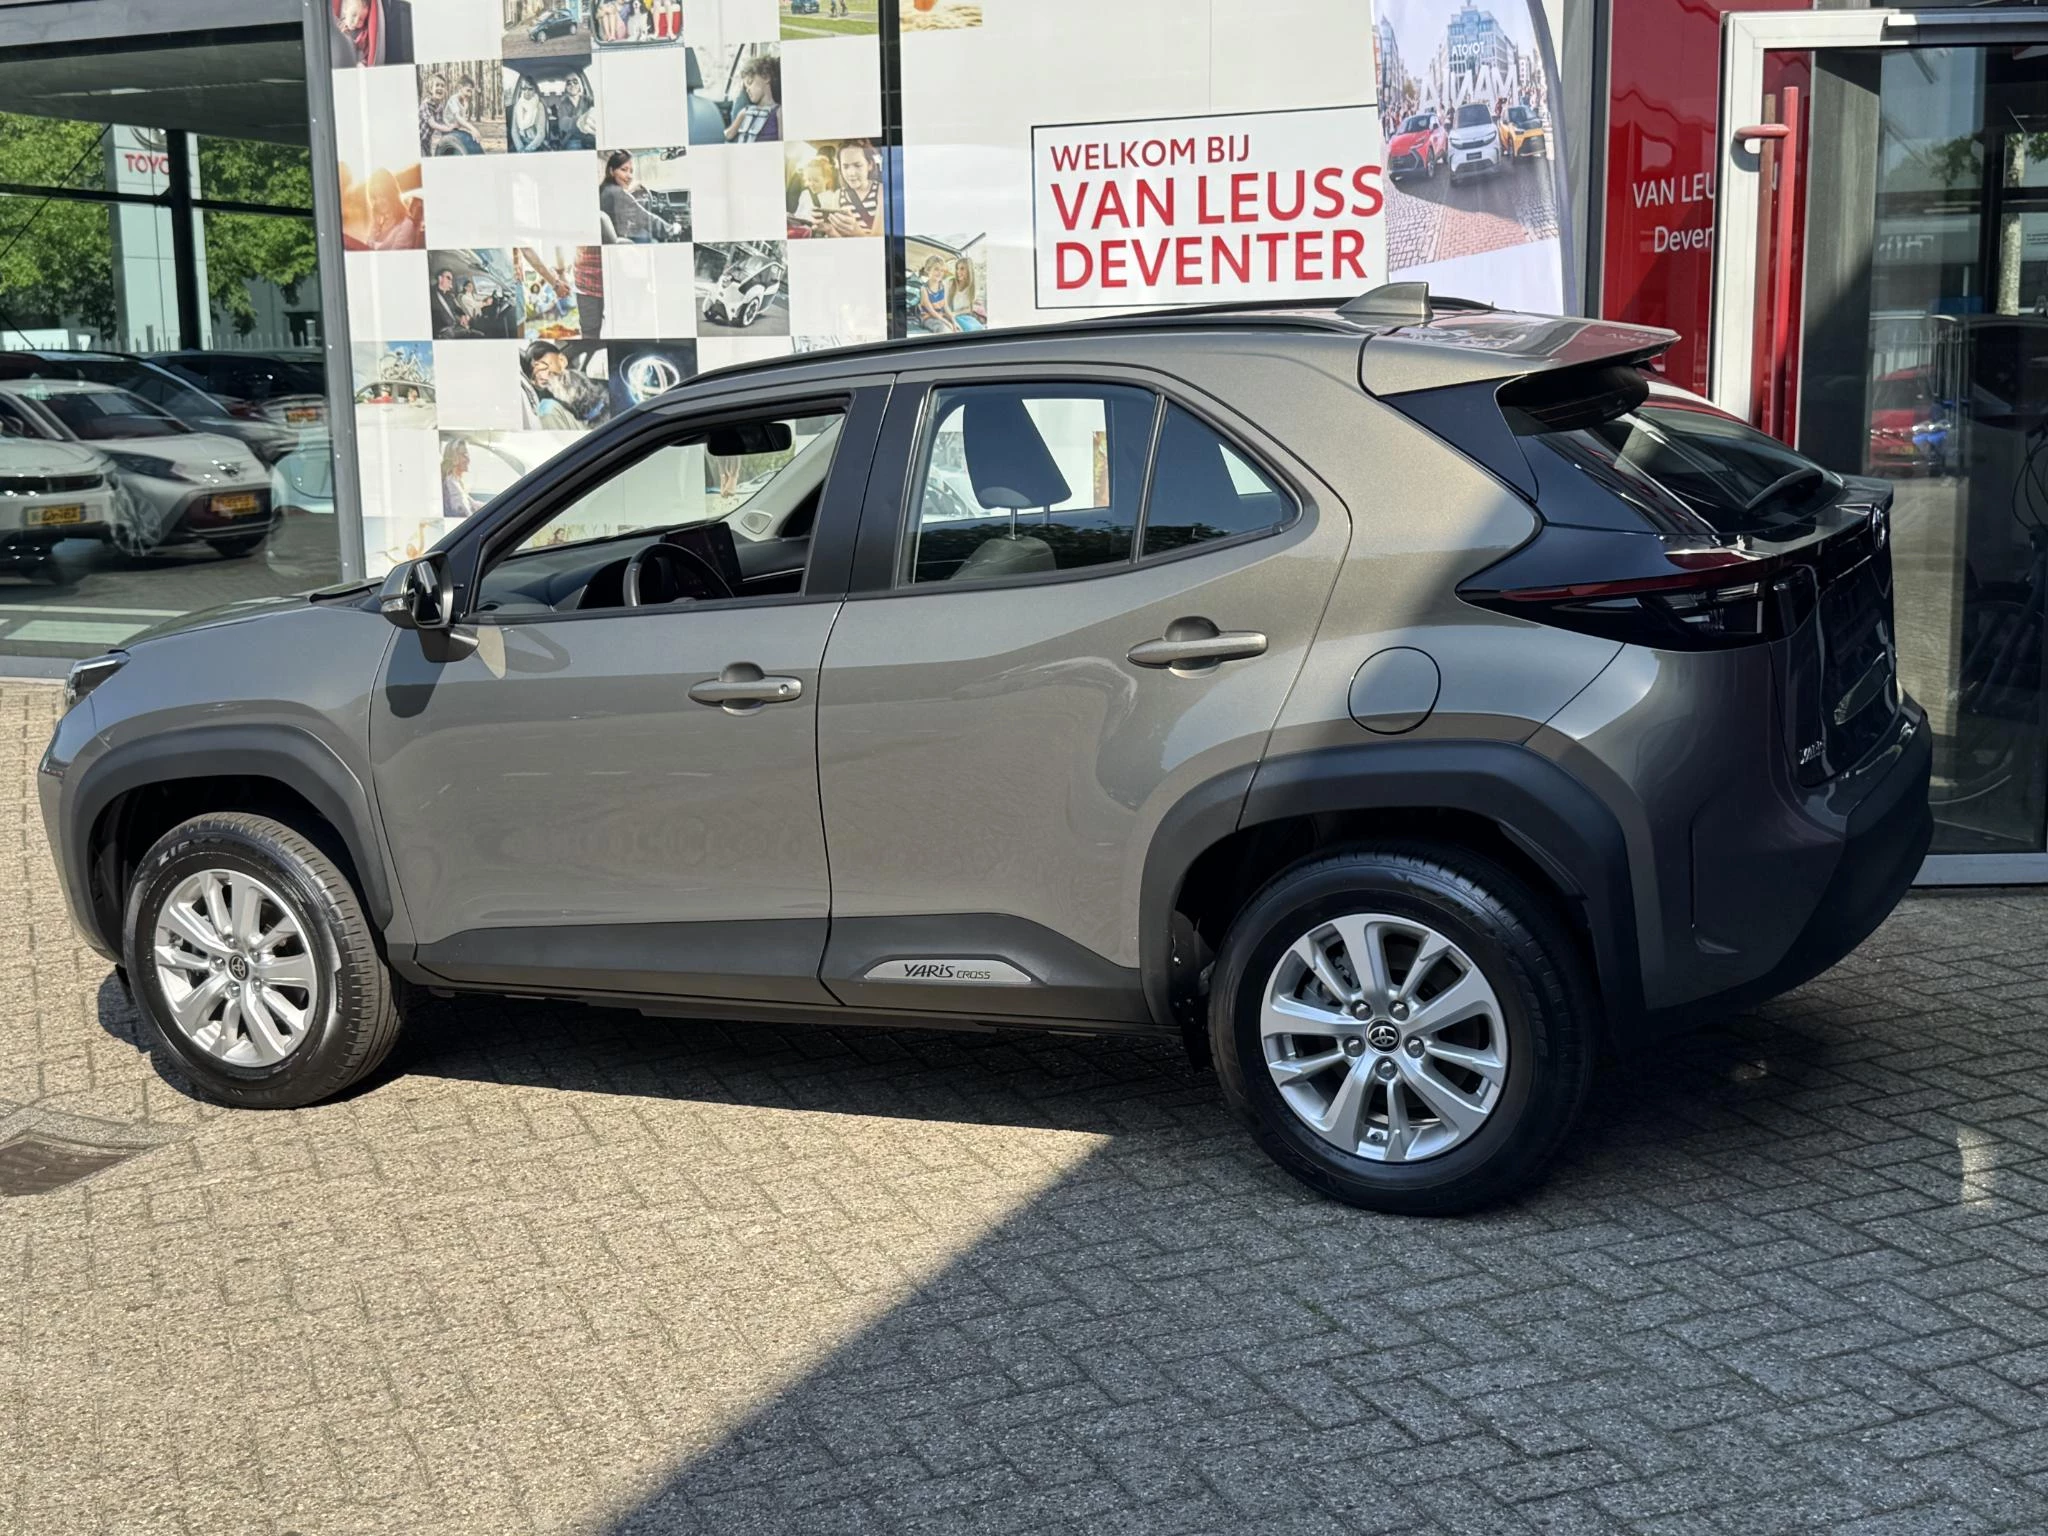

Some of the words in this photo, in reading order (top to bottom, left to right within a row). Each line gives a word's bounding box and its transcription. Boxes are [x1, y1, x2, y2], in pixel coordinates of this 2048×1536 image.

[124, 152, 170, 175] TOYO
[1050, 137, 1196, 172] WELKOM
[1207, 134, 1250, 163] BIJ
[1050, 177, 1175, 231] VAN
[1632, 177, 1675, 209] VAN
[1681, 172, 1715, 203] LEU
[1056, 229, 1368, 290] DEVENTER
[956, 970, 991, 980] CROSS
